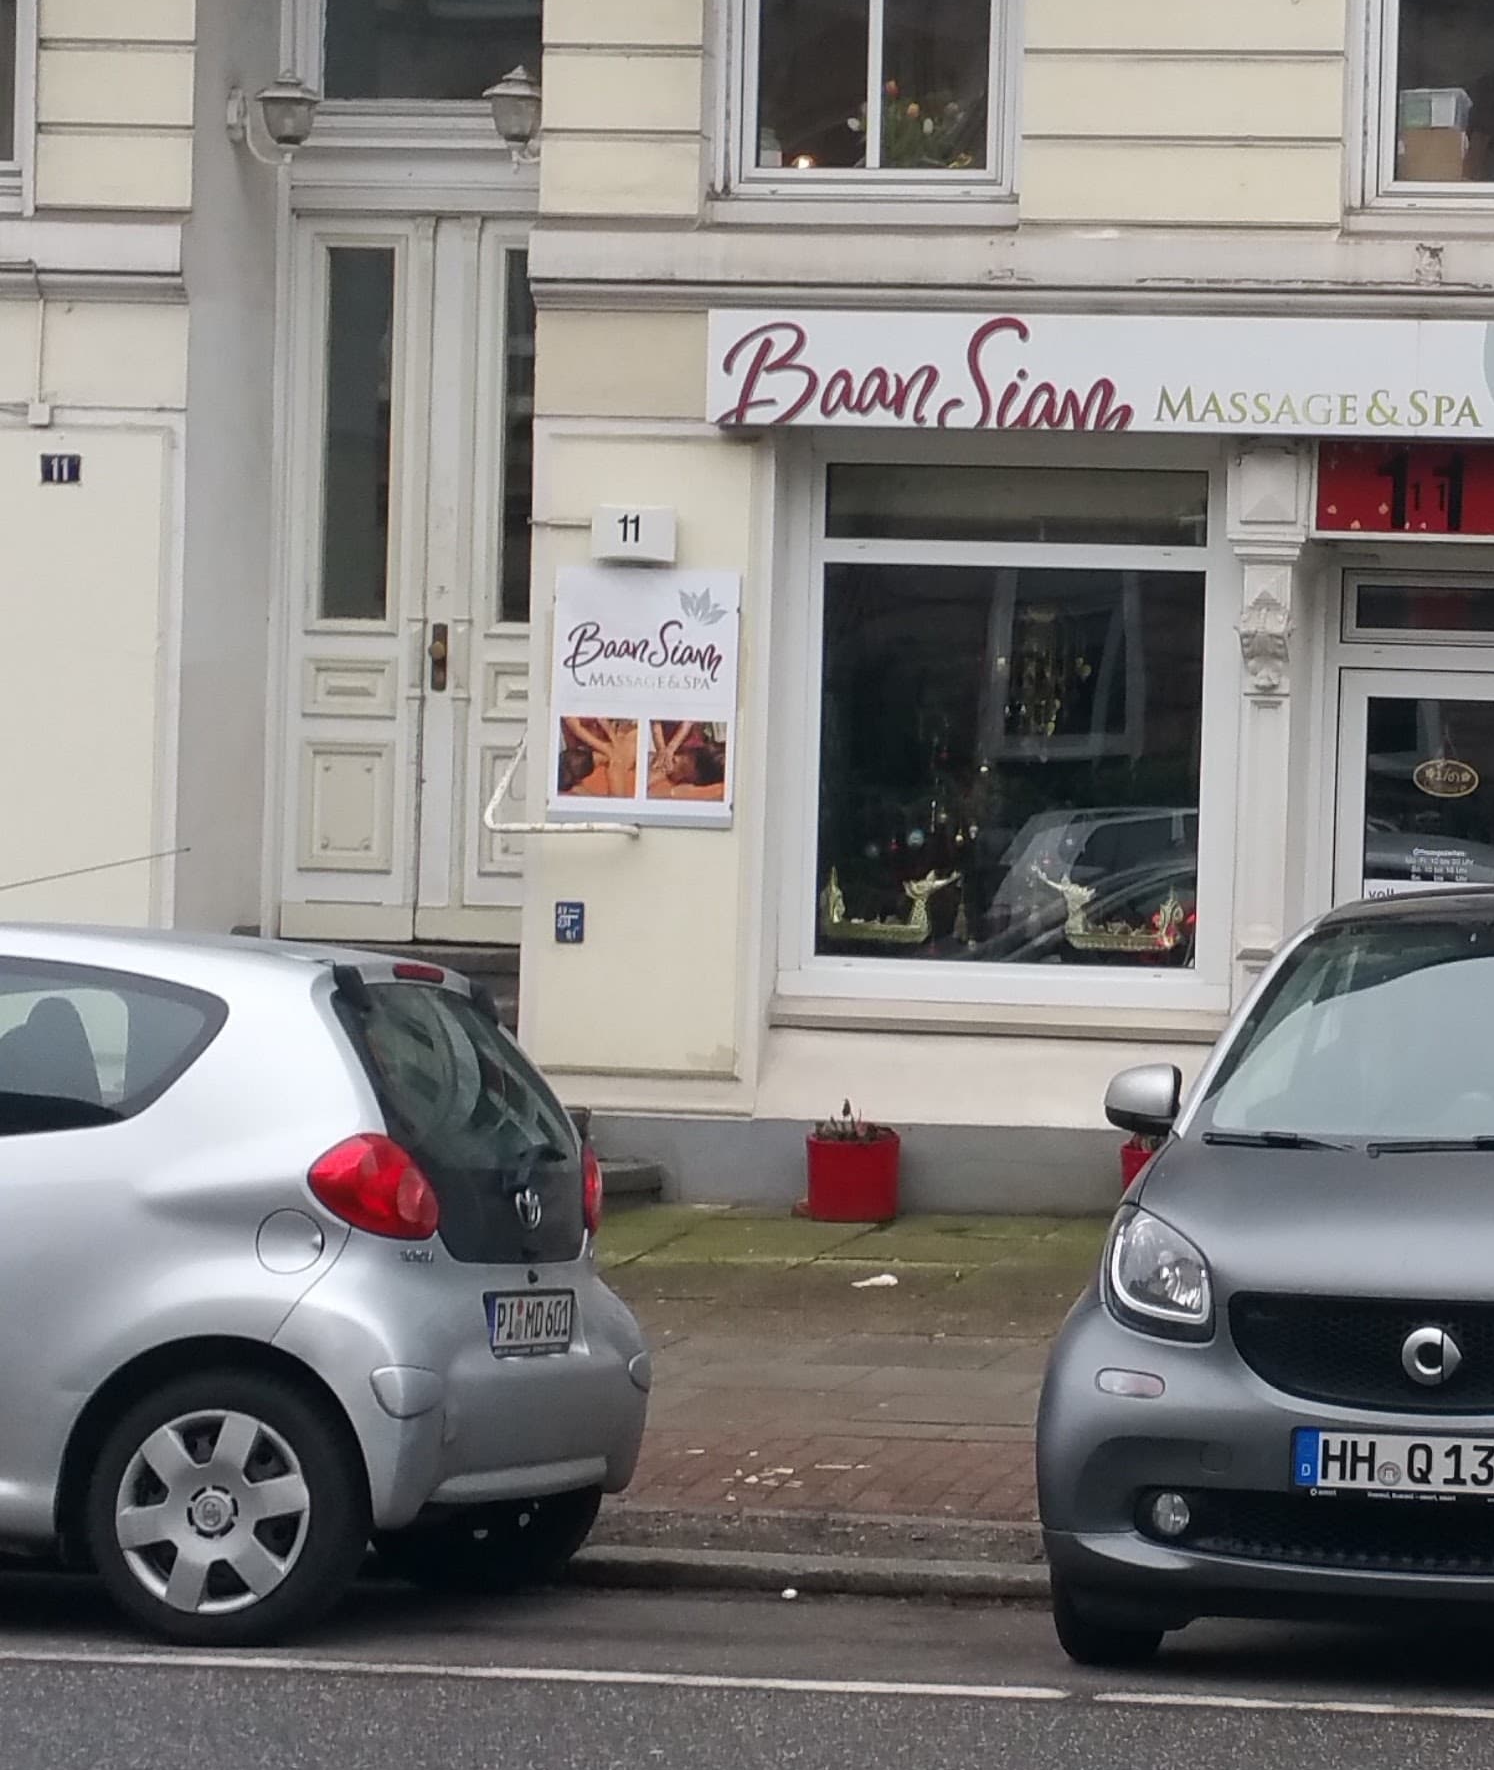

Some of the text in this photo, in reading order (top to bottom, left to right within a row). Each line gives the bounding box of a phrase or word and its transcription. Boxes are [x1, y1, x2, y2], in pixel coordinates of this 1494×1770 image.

[712, 319, 939, 426] Baan
[938, 316, 1135, 430] Siam
[51, 457, 69, 481] 11
[618, 514, 641, 543] 11
[563, 620, 723, 687] Baan Siam
[496, 1301, 514, 1341] PI
[1301, 1463, 1311, 1476] D
[1321, 1439, 1376, 1482] HH
